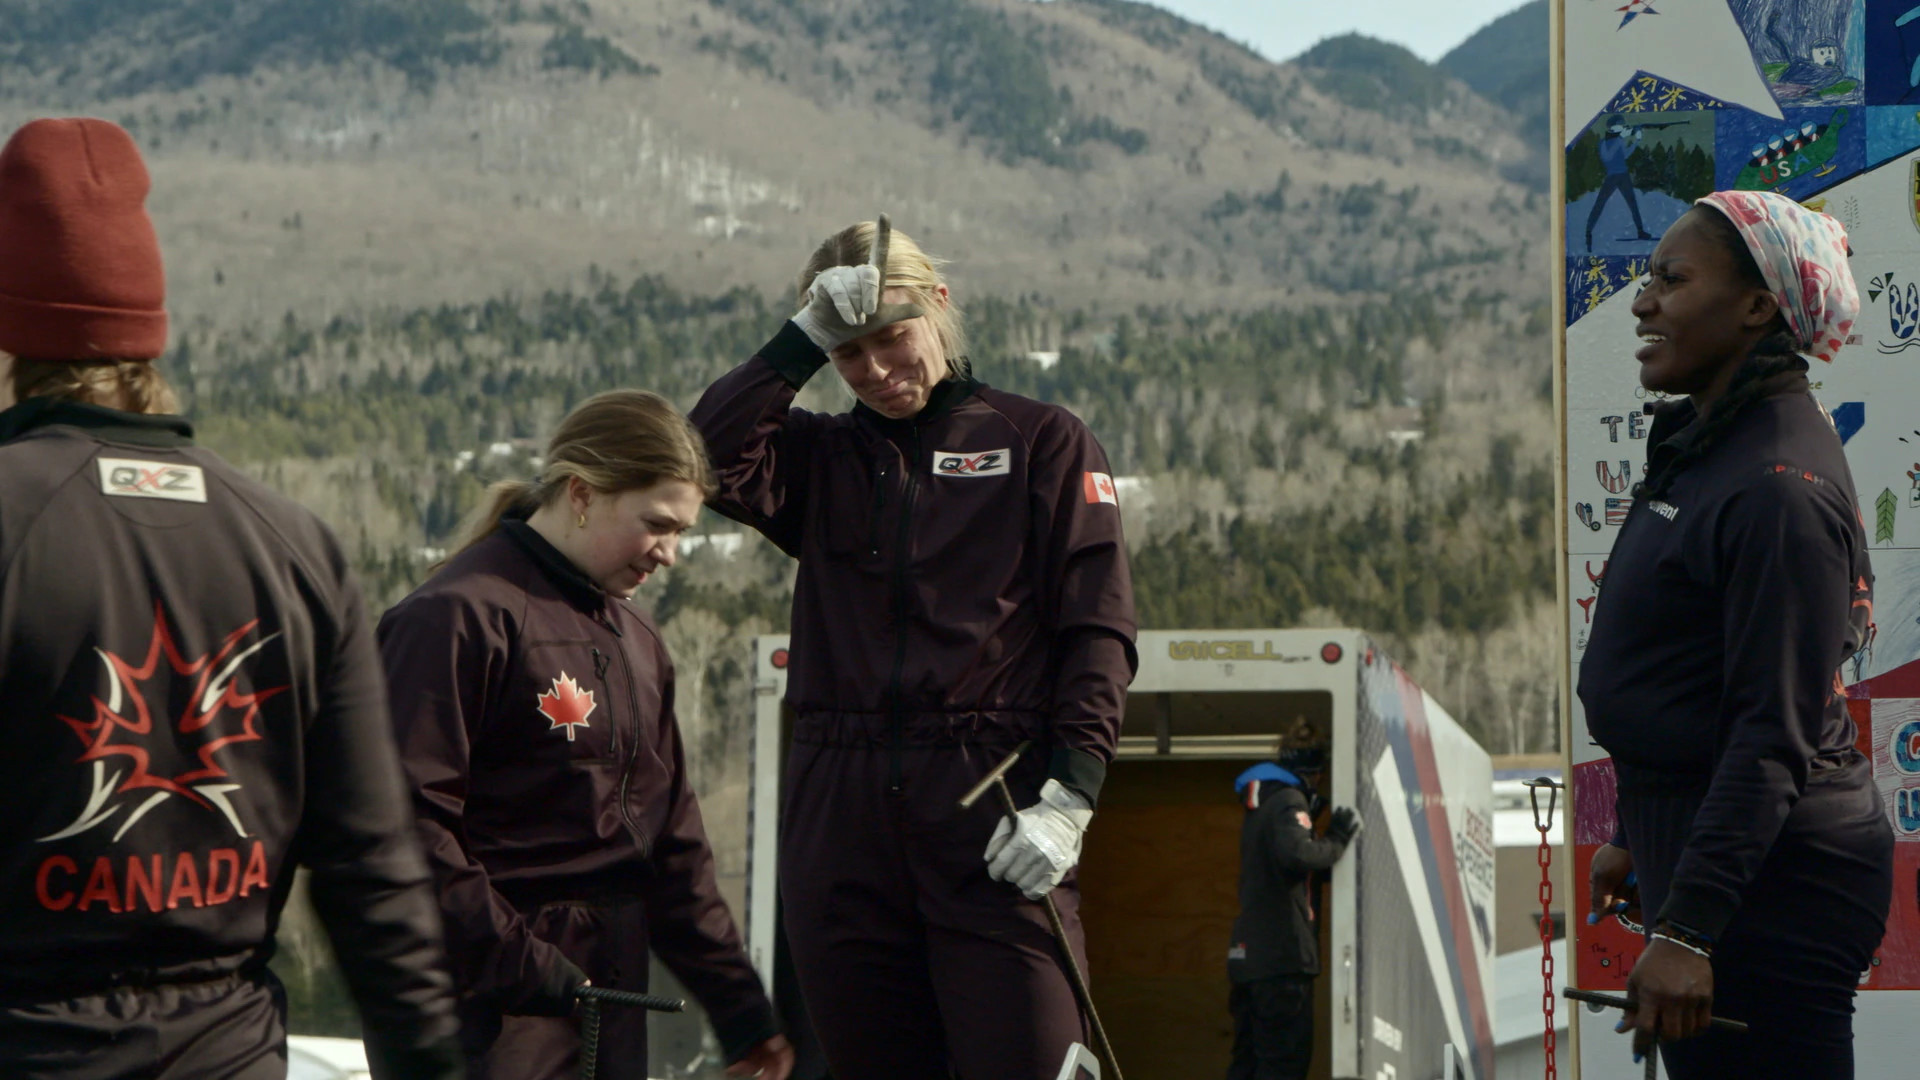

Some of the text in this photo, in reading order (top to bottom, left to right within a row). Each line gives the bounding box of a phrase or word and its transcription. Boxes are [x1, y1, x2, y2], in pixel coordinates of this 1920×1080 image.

[1759, 151, 1811, 185] USA
[939, 453, 1004, 474] QXZ
[1763, 463, 1825, 487] APPIAH
[110, 466, 196, 493] QXZ
[1168, 639, 1284, 661] UNICELL
[35, 840, 271, 914] CANADA
